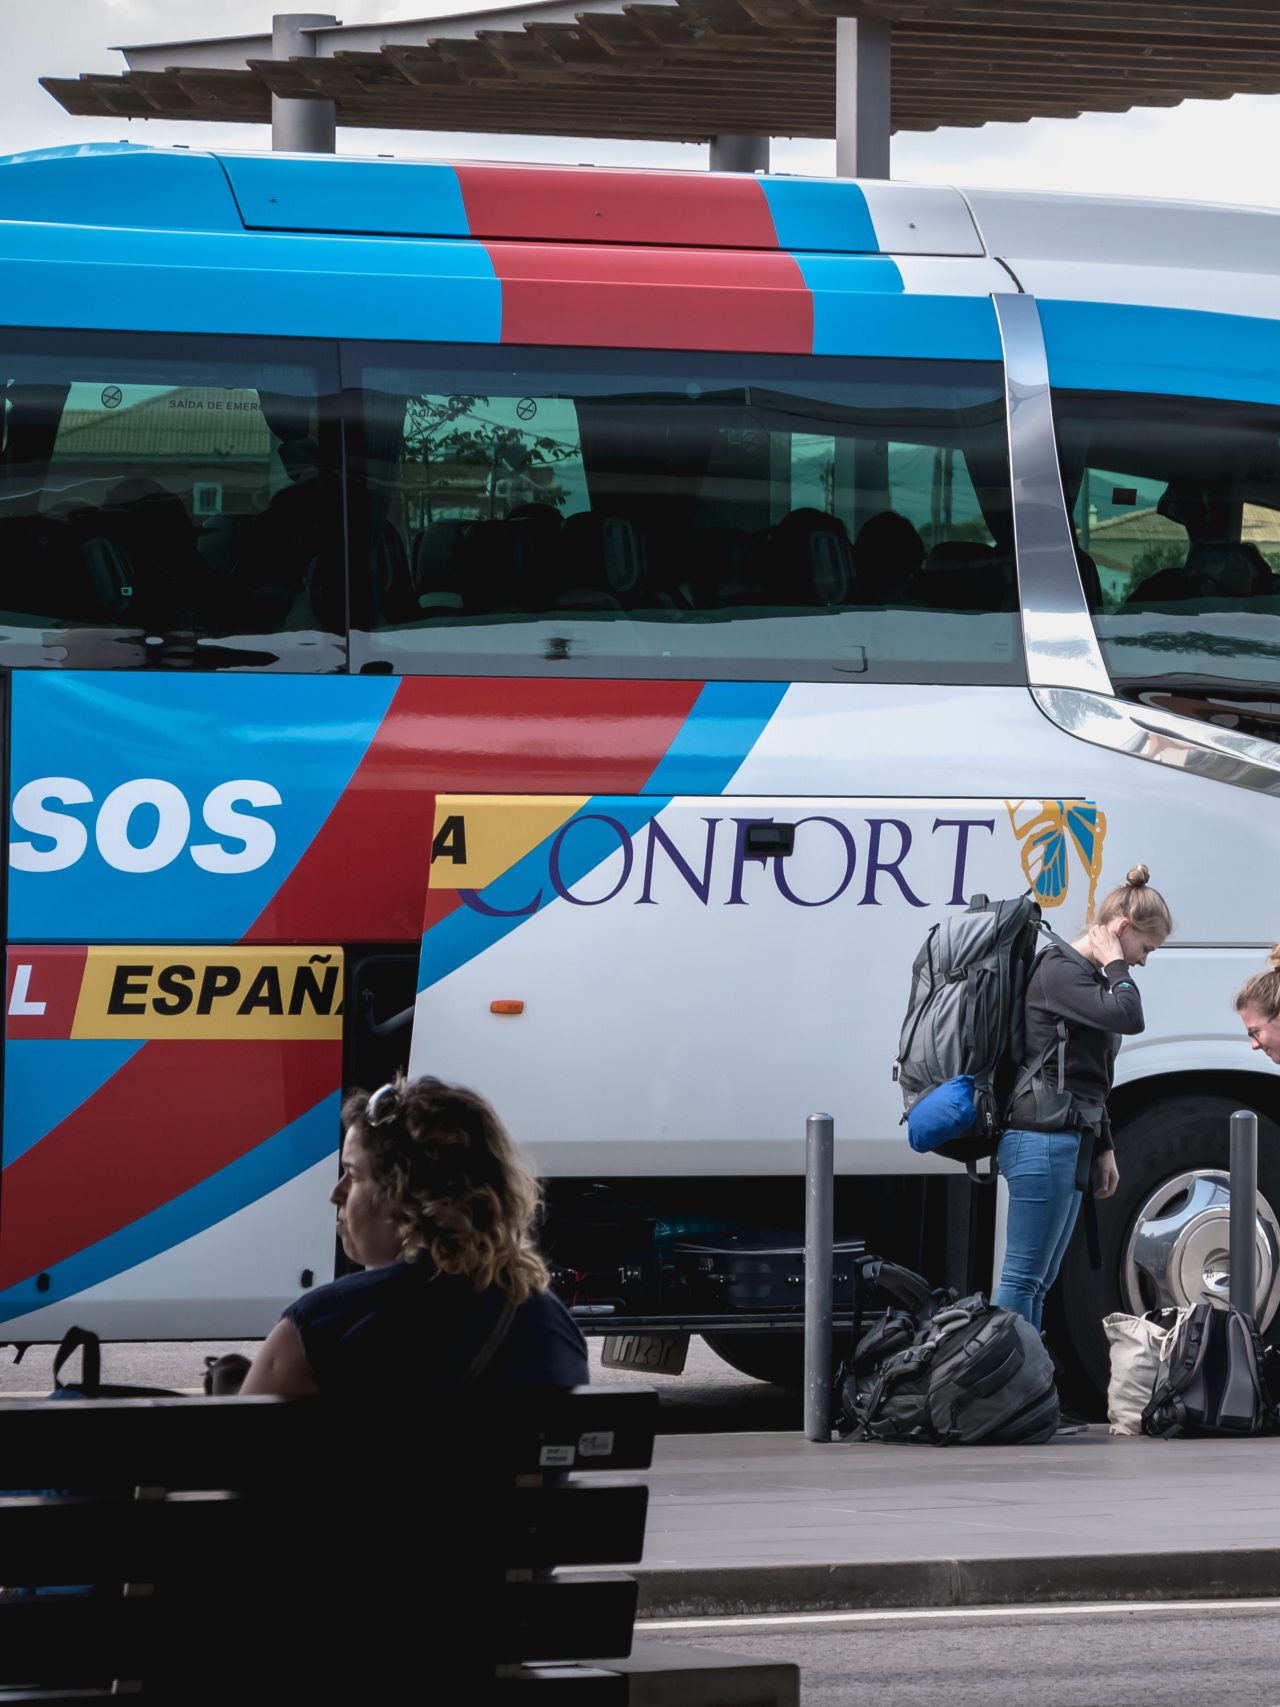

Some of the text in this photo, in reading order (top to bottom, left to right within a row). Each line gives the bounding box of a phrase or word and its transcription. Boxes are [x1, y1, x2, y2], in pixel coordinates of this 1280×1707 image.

[169, 398, 204, 409] SAÍDA
[207, 401, 223, 410] DE
[8, 776, 283, 874] SOS
[107, 953, 344, 1016] ESPAÑ
